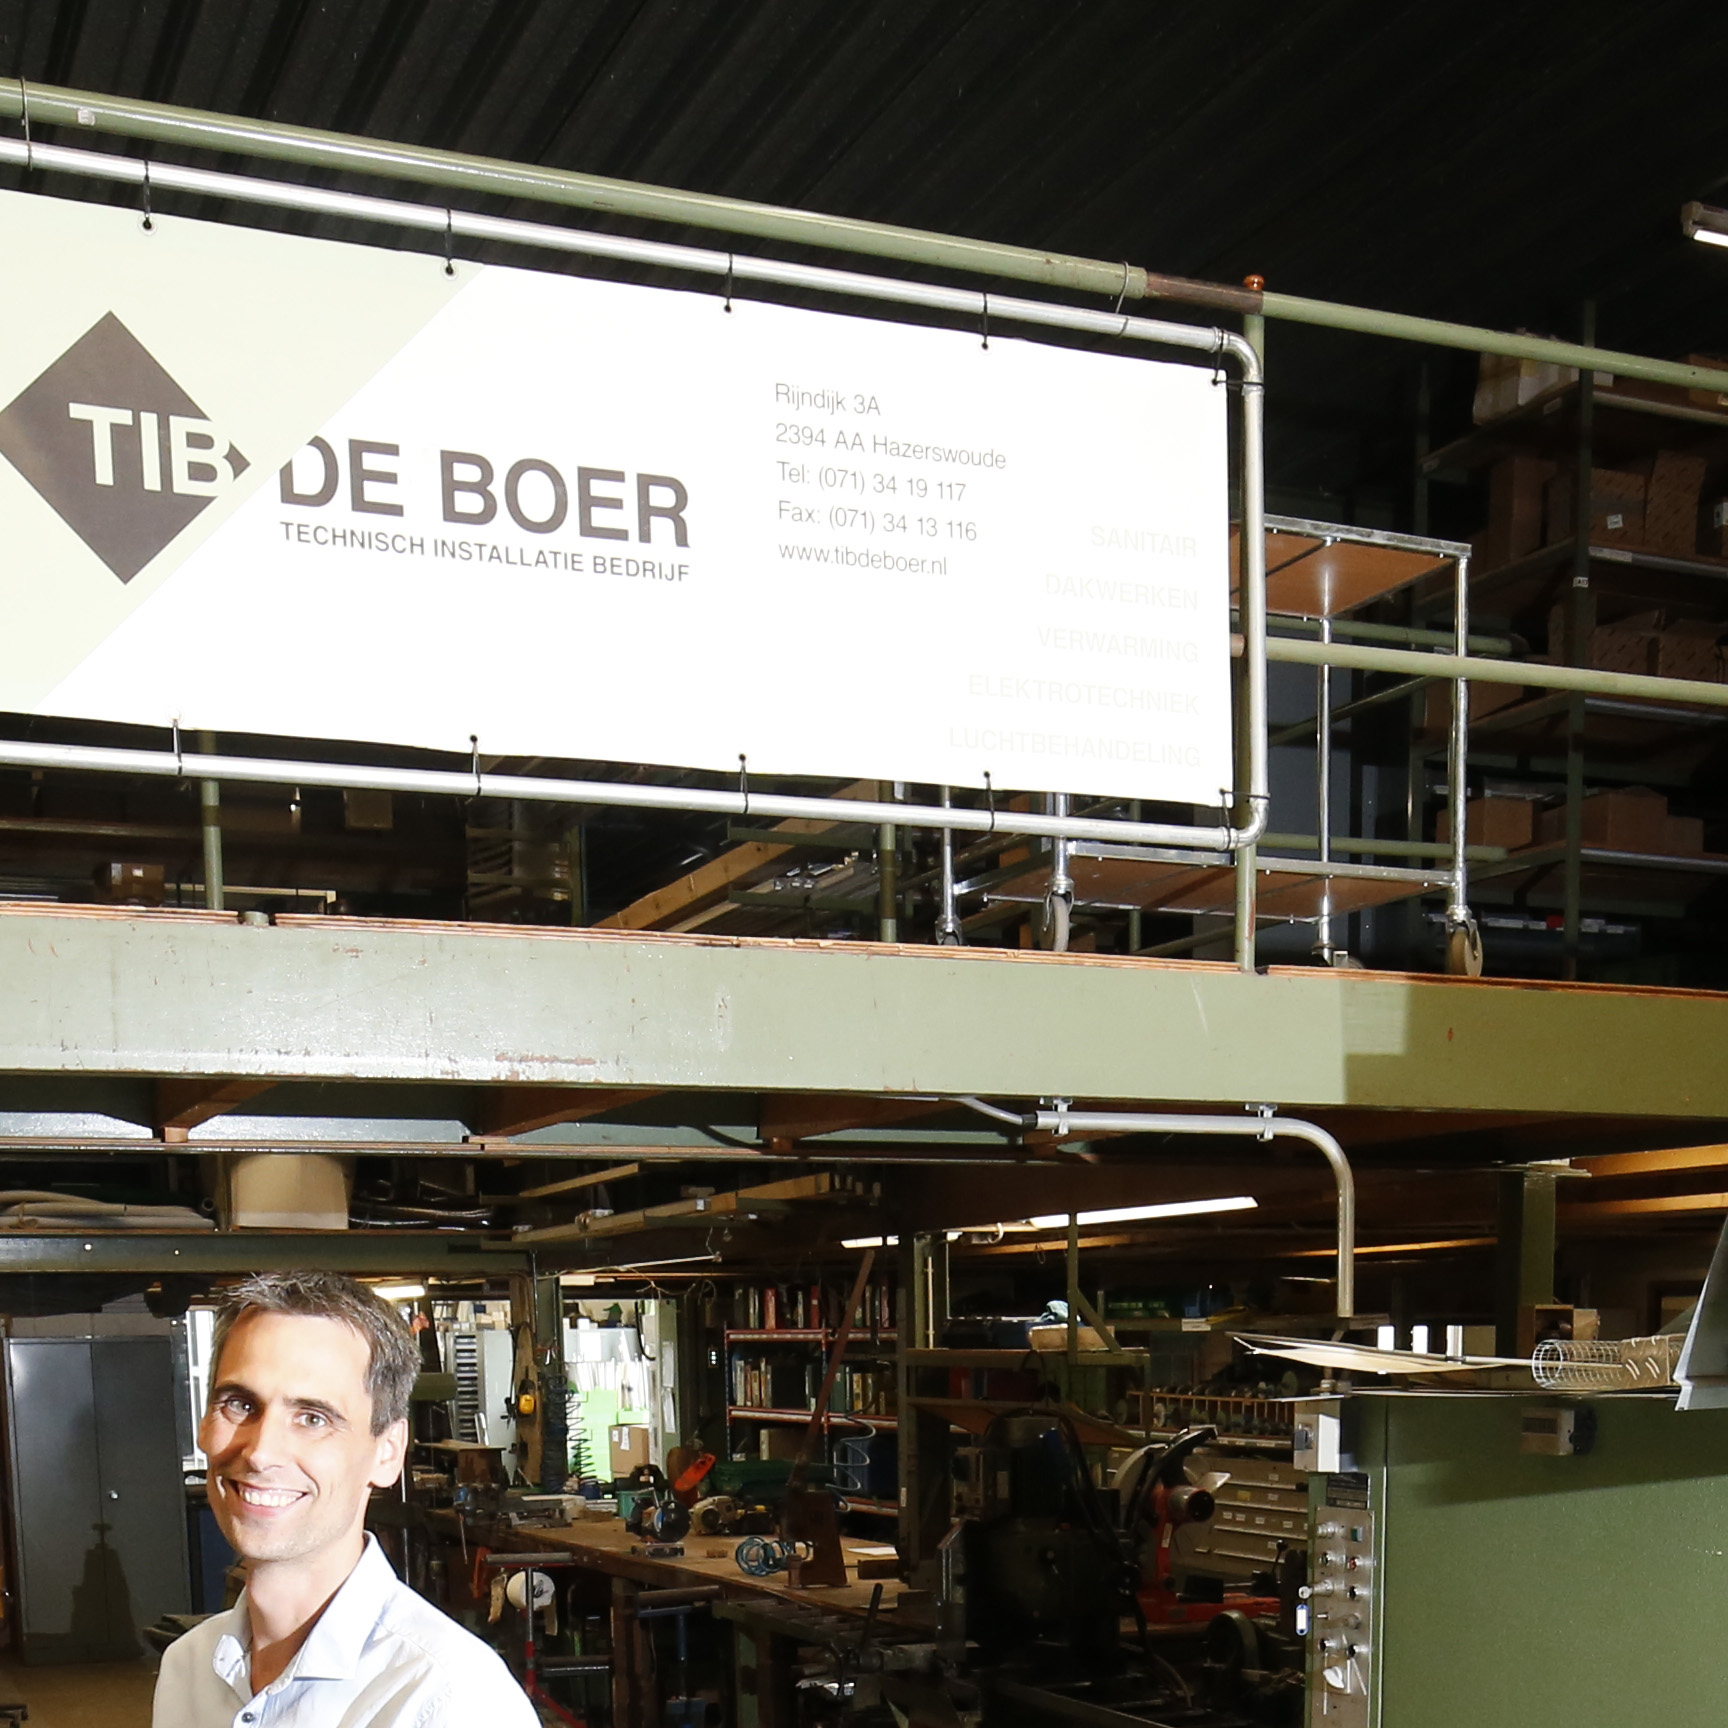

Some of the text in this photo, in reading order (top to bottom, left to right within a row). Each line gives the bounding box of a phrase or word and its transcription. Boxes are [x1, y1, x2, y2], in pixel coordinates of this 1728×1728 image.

[775, 383, 882, 416] Rijndijk 3A
[68, 402, 230, 498] TIB
[776, 422, 1007, 470] 2394 AA Hazerswoude
[279, 435, 691, 548] DE BOER
[777, 460, 967, 502] Tel: (071) 34 19 117
[778, 500, 978, 542] Fax: (071) 34 13 116
[1090, 525, 1198, 558] SANITAIR
[280, 521, 691, 583] TECHNISCH INSTALLATIE BEDRIJF
[778, 543, 948, 576] www.tibdeboer.nl
[1045, 573, 1199, 611] DAKWERKEN
[1036, 625, 1200, 664] VERWARMING
[968, 673, 1201, 716] ELEKTROTECHNIEK
[949, 726, 1202, 767] LUCHTBEHANDELING
